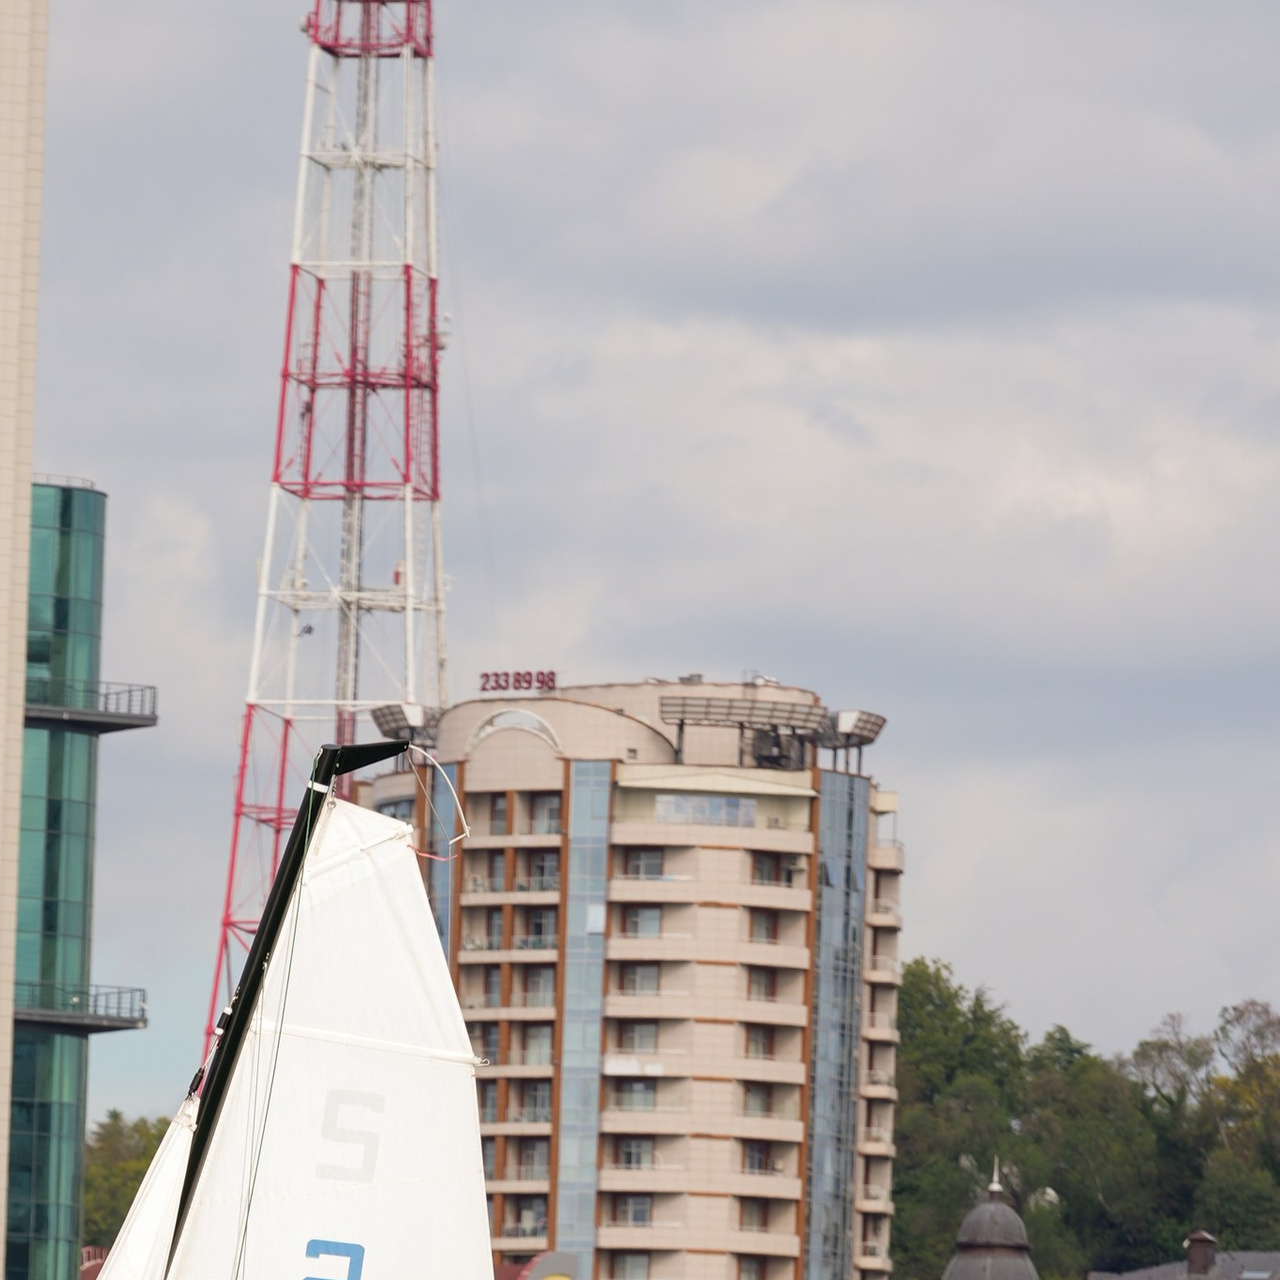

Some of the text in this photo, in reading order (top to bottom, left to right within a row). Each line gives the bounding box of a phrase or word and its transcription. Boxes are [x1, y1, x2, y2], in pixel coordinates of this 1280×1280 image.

[480, 670, 556, 691] 233 89 98
